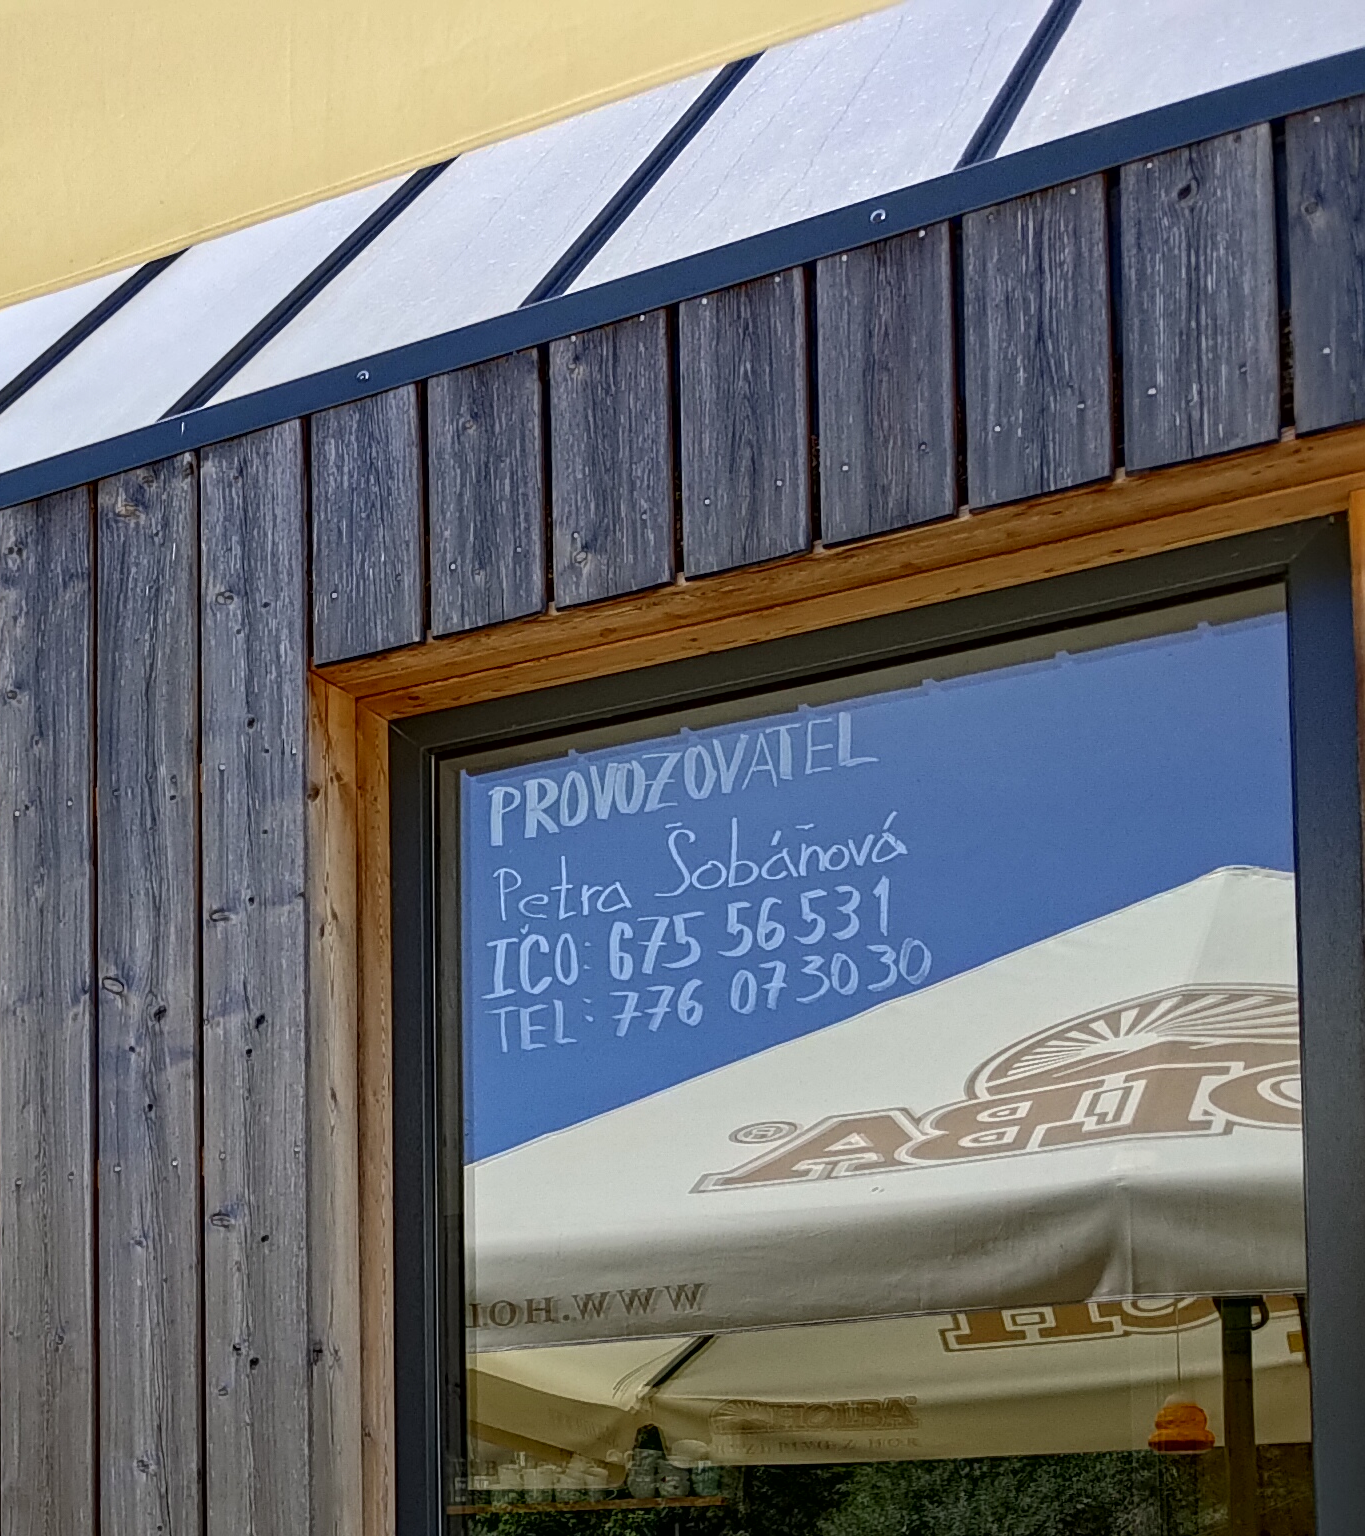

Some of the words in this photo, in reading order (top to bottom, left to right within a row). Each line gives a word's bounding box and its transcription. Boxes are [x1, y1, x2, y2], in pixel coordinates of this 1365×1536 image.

[488, 711, 879, 847] PROVOZOVATEL
[492, 856, 633, 922] Petra
[481, 923, 591, 1000] IČO:
[608, 911, 705, 981] 675
[484, 997, 595, 1053] TEL:
[610, 979, 705, 1037] 776
